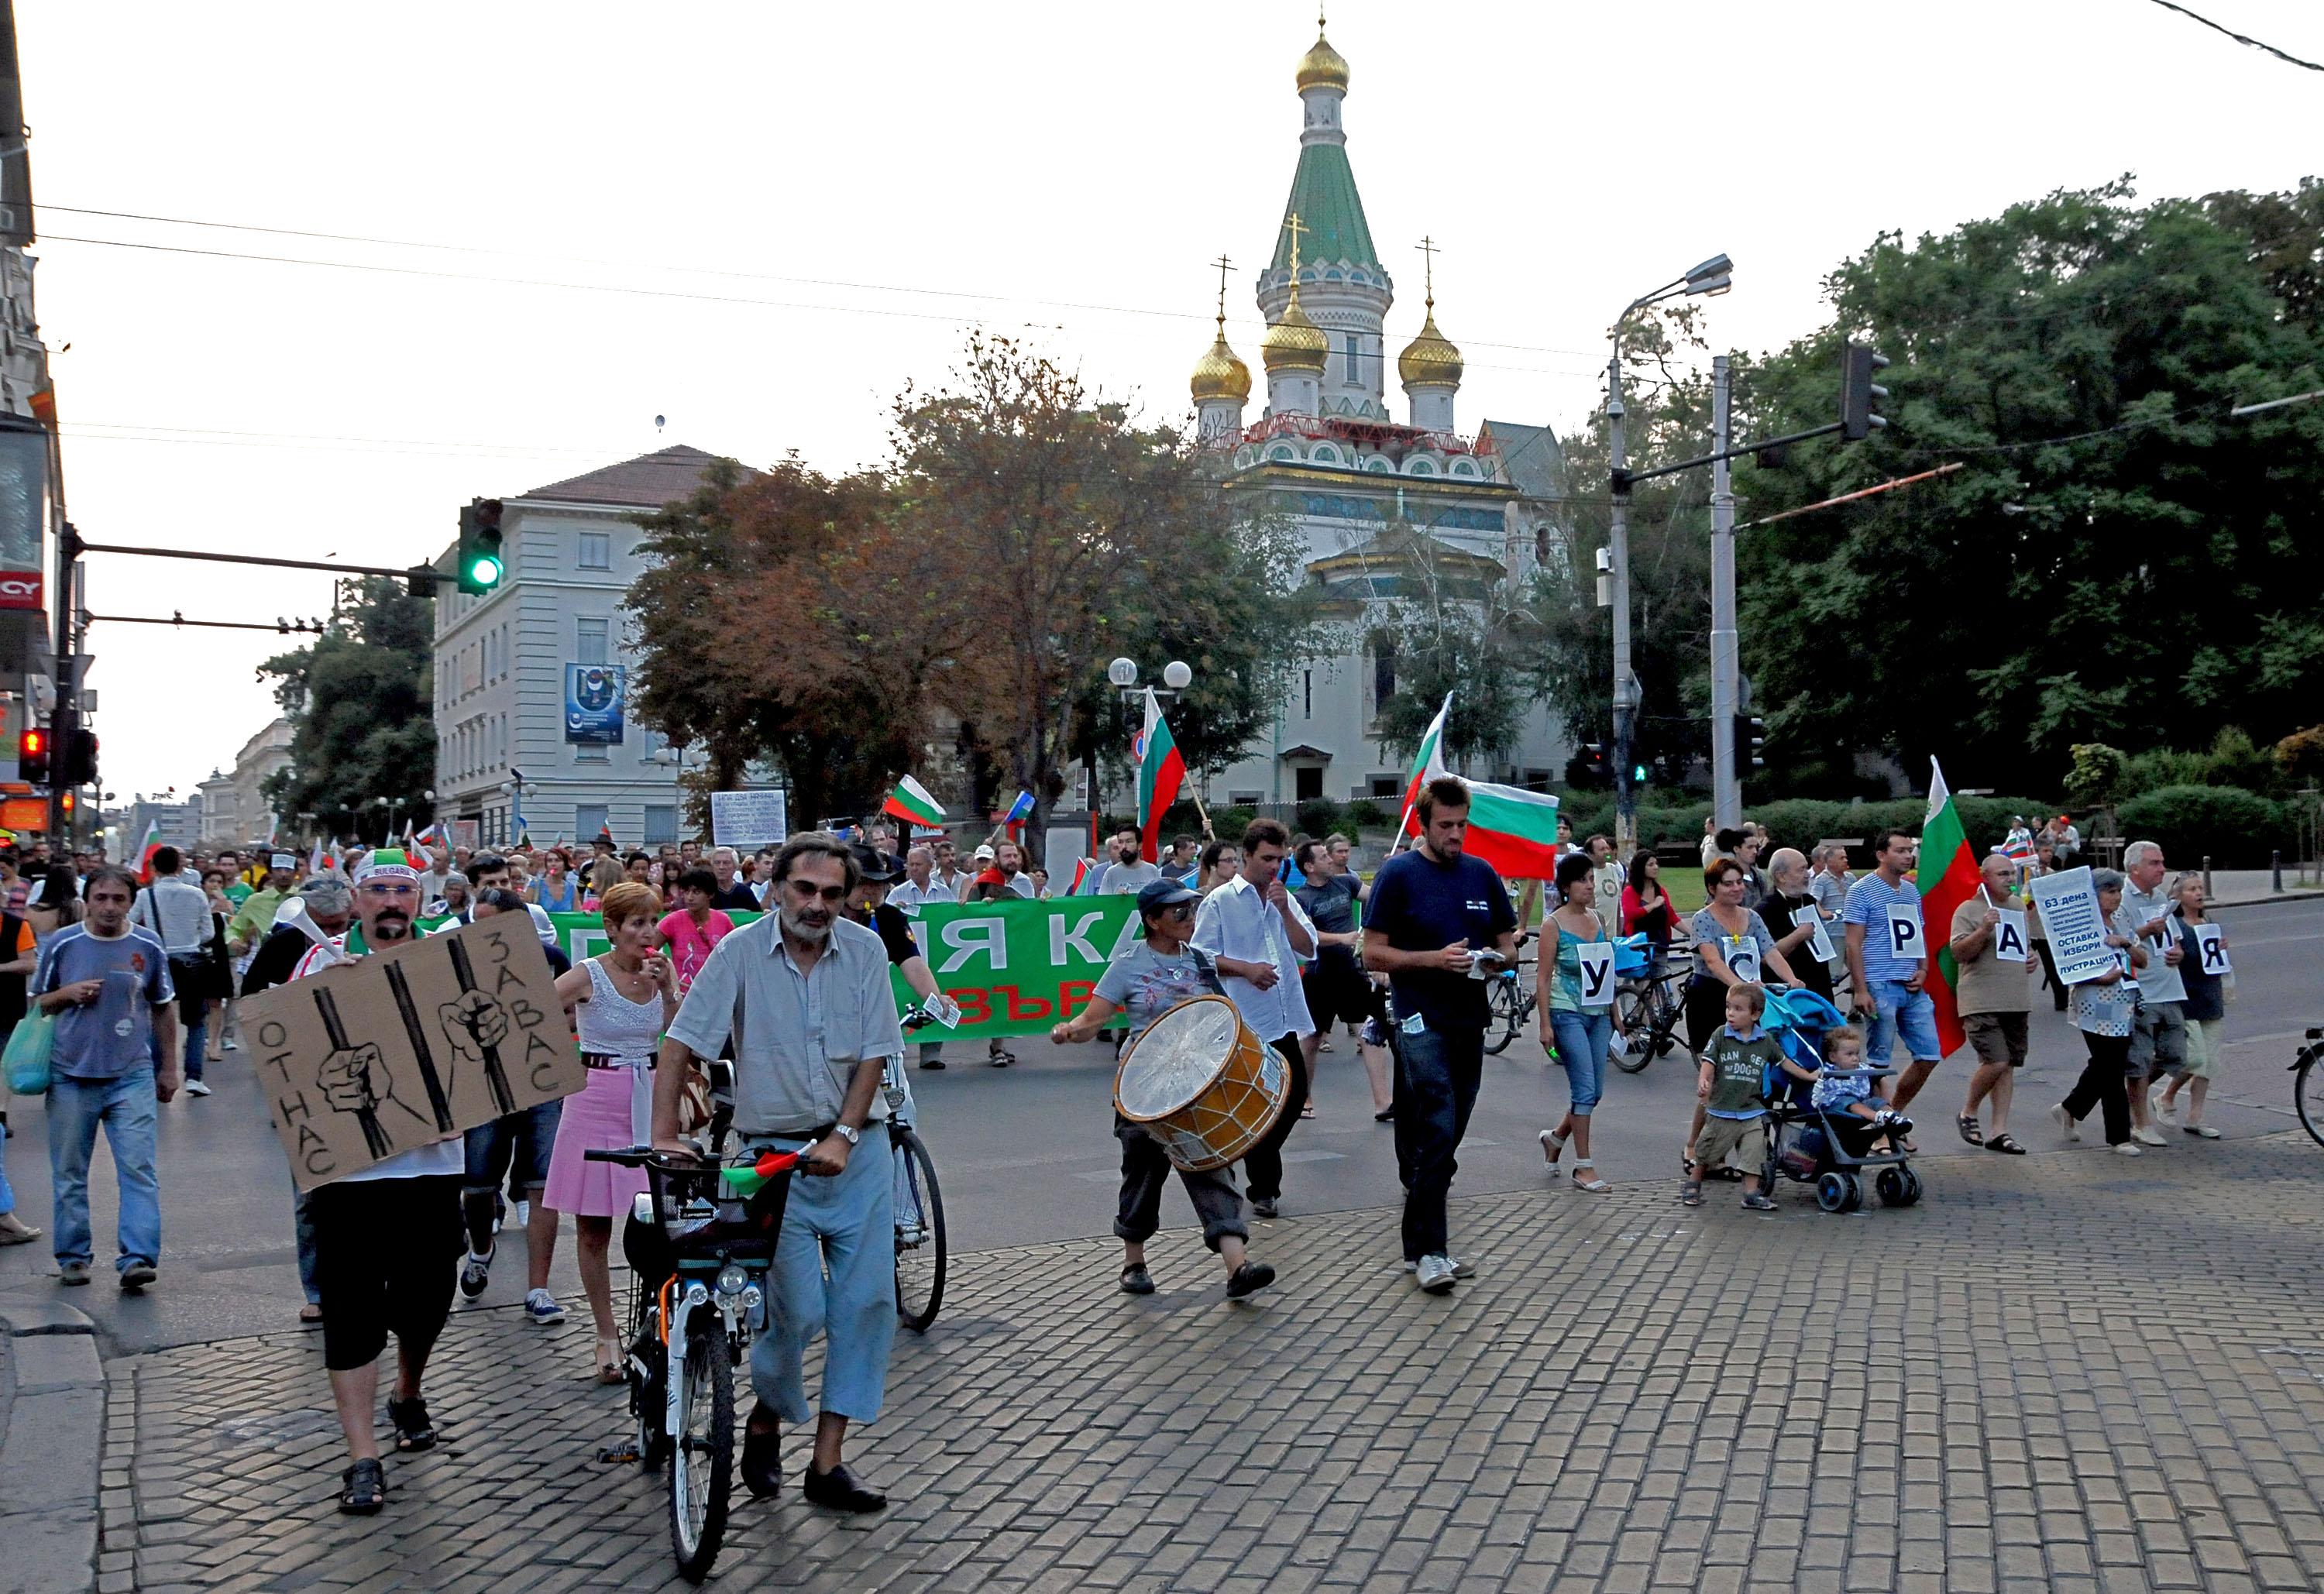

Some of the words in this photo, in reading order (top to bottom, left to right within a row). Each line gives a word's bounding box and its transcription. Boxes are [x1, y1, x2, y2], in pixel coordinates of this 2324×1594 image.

[2045, 898, 2058, 908] 63
[2061, 892, 2089, 905] дена
[1892, 919, 1916, 951] Р
[1998, 923, 2025, 955] А
[2058, 931, 2099, 946] ОСТАВКА
[2064, 942, 2101, 957] ИЗБОРИ
[2203, 937, 2225, 968] Я
[2059, 954, 2115, 974] ЛУСТРАЦИЯ
[1581, 959, 1610, 998] У
[1734, 1063, 1752, 1076] DOG
